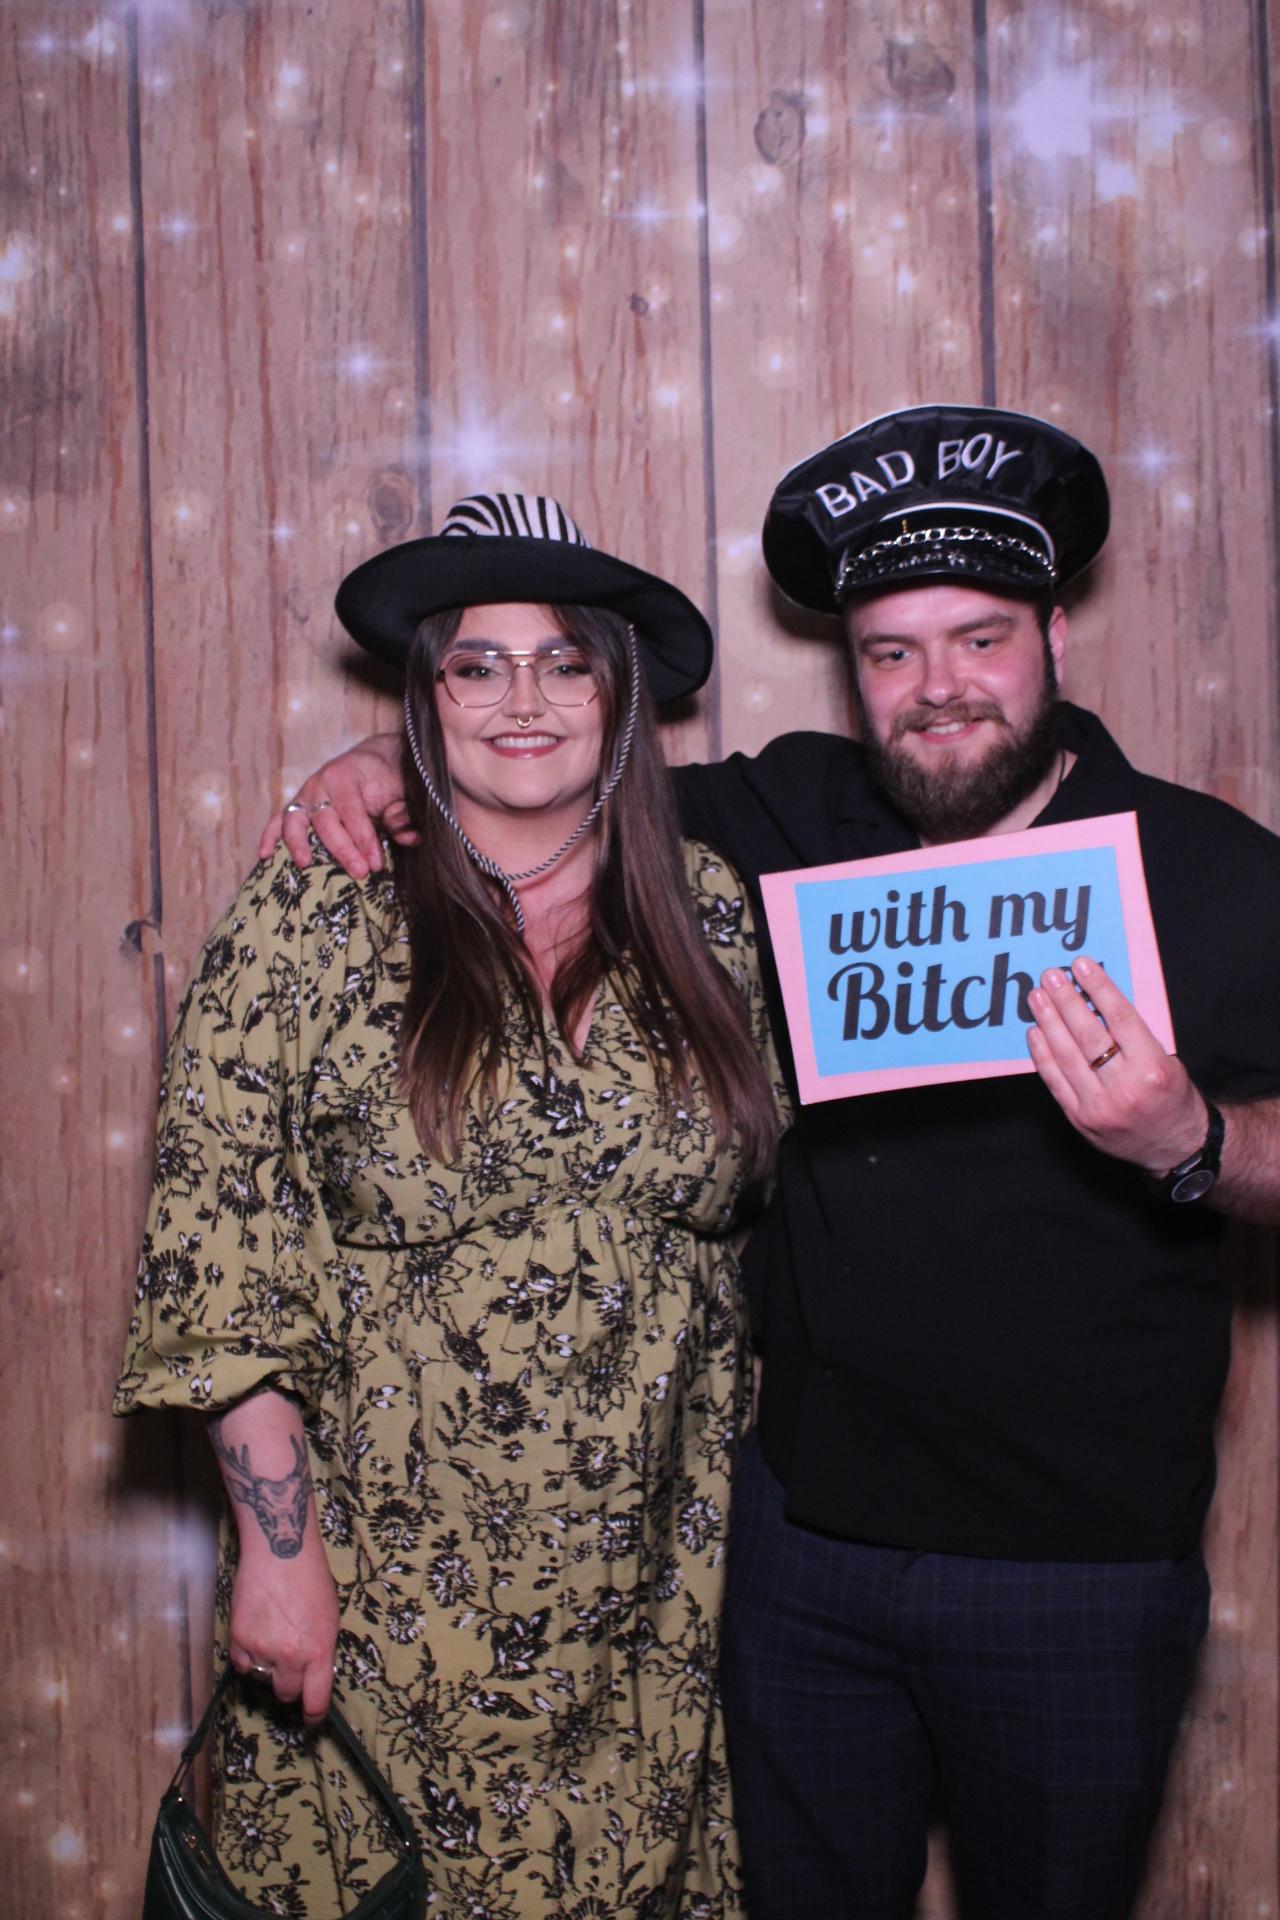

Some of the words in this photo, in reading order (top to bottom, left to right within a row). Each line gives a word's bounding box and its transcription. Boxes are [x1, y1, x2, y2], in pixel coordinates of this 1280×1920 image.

[814, 450, 915, 518] BAD
[937, 432, 1023, 480] BOY
[828, 884, 969, 955] with
[988, 884, 1092, 952] my
[827, 952, 1105, 1041] Bitch
